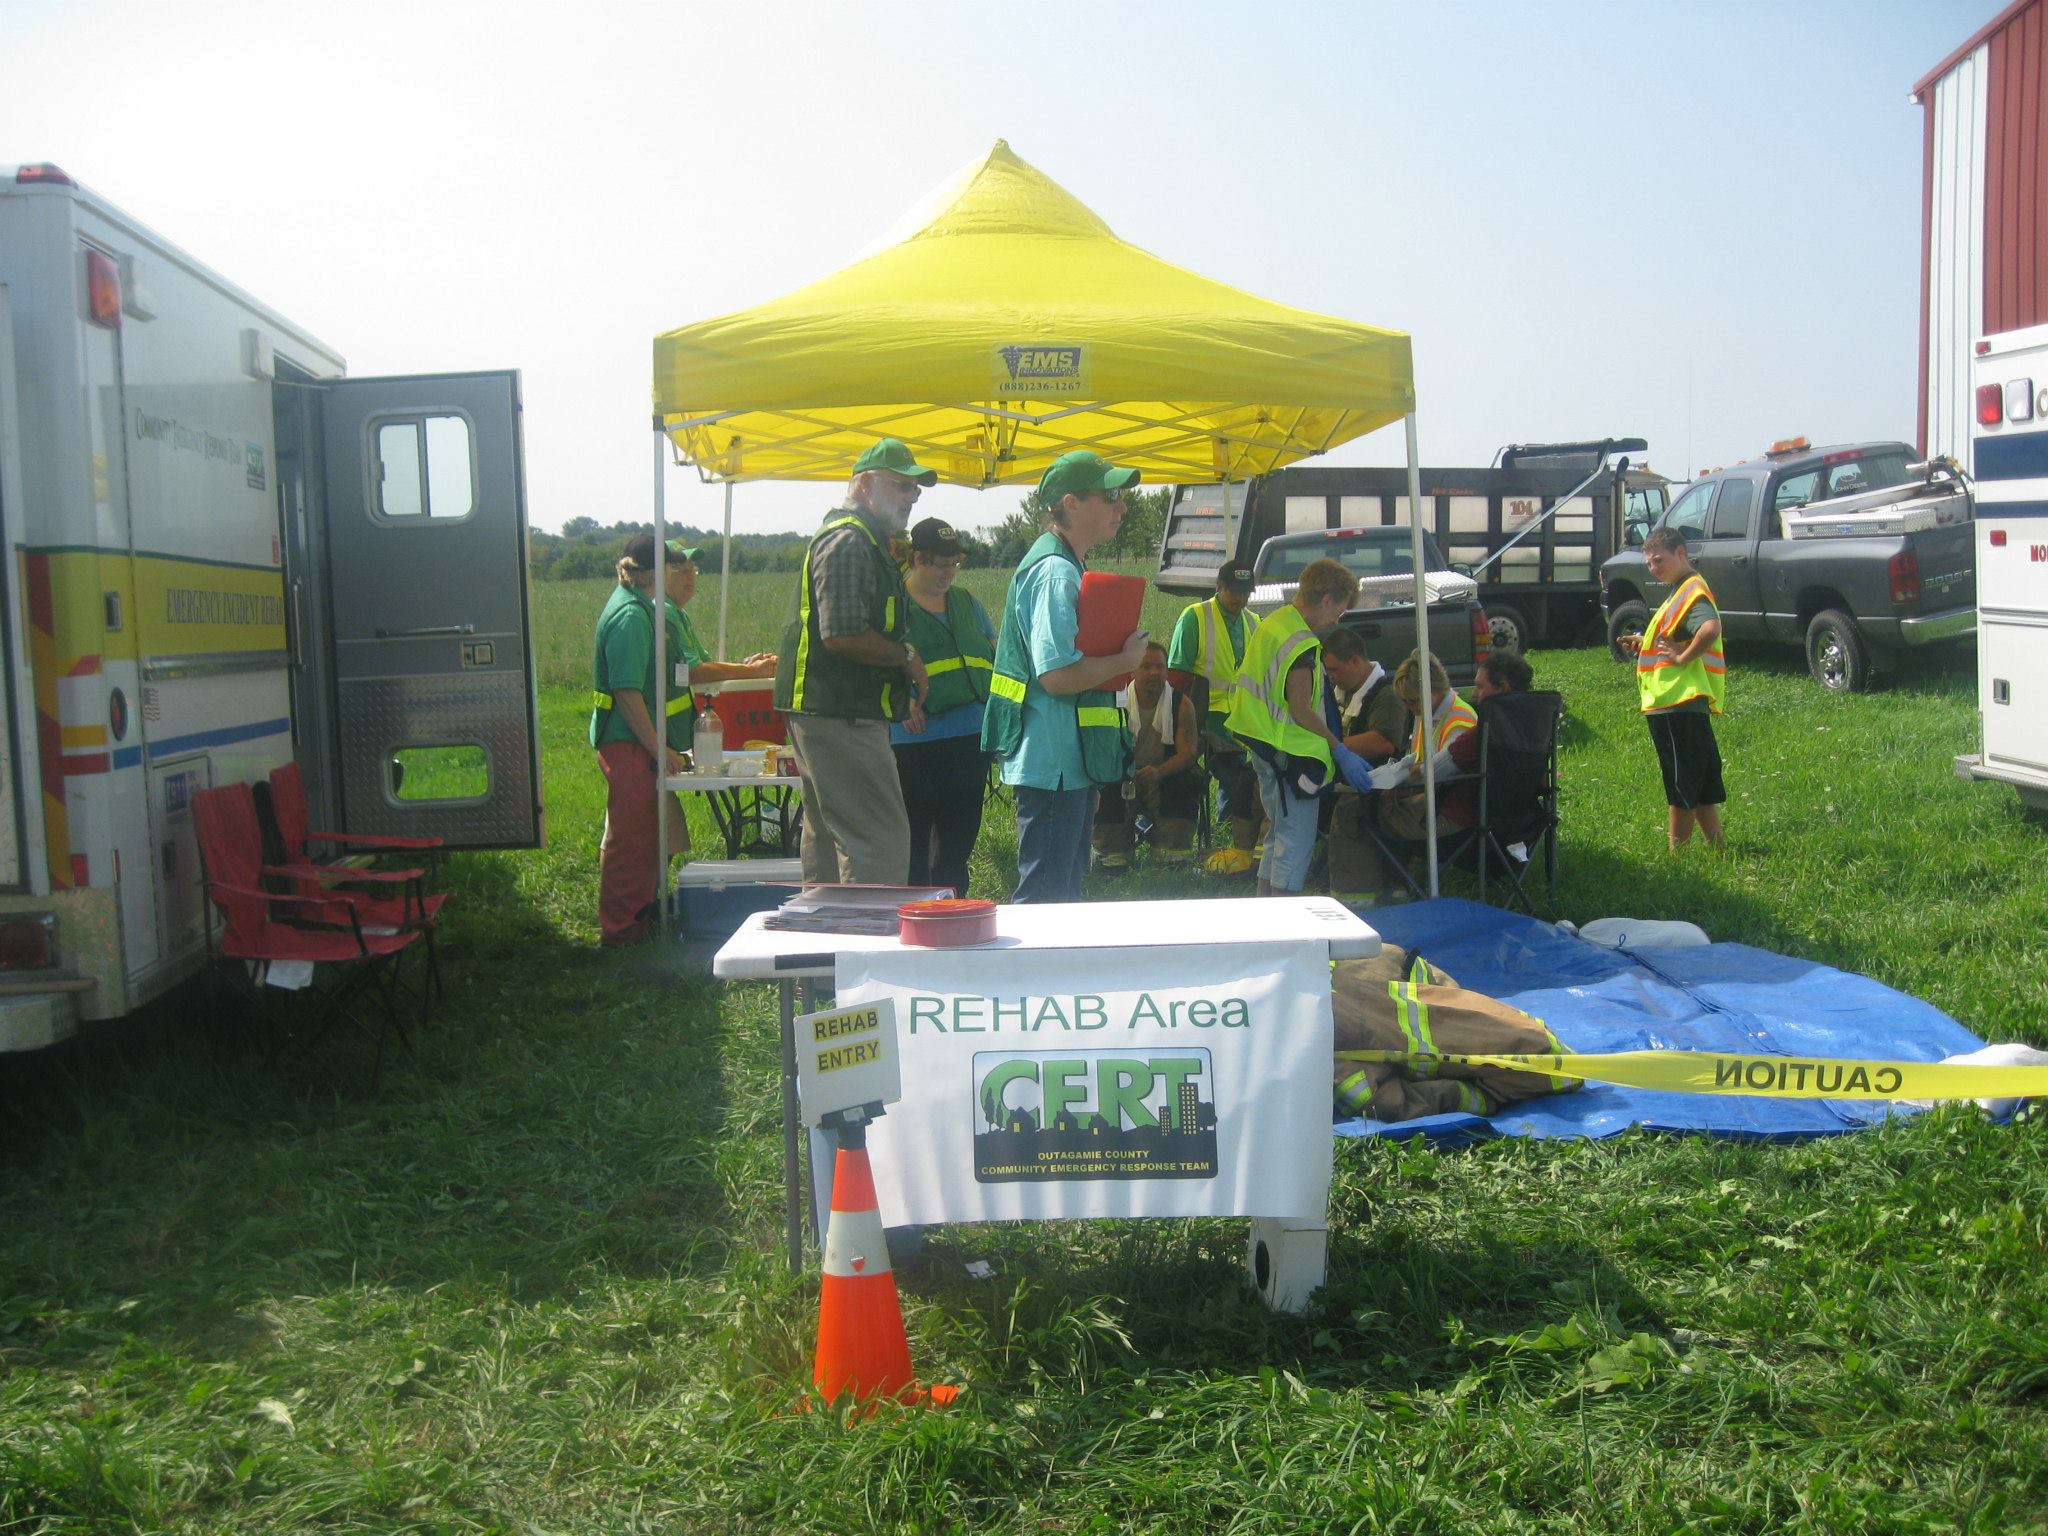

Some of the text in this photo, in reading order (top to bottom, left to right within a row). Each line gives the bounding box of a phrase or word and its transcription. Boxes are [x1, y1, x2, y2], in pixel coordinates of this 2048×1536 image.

[1019, 351, 1074, 368] EMS
[1019, 366, 1079, 375] INNOVATIONS
[999, 382, 1081, 392] (888)236-1267
[1509, 500, 1534, 516] 104
[166, 588, 220, 624] EMERGENCY
[223, 592, 259, 624] INCIDENT
[910, 993, 1250, 1034] REHAB Area
[814, 1011, 878, 1040] REHAB
[817, 1041, 879, 1071] ENTRY
[980, 1058, 1203, 1130] CERT
[1037, 1149, 1150, 1161] OUTAGAMIE COUNTY
[981, 1161, 1210, 1175] COMMUNITY EMERGENCY RESPONSE TEAM
